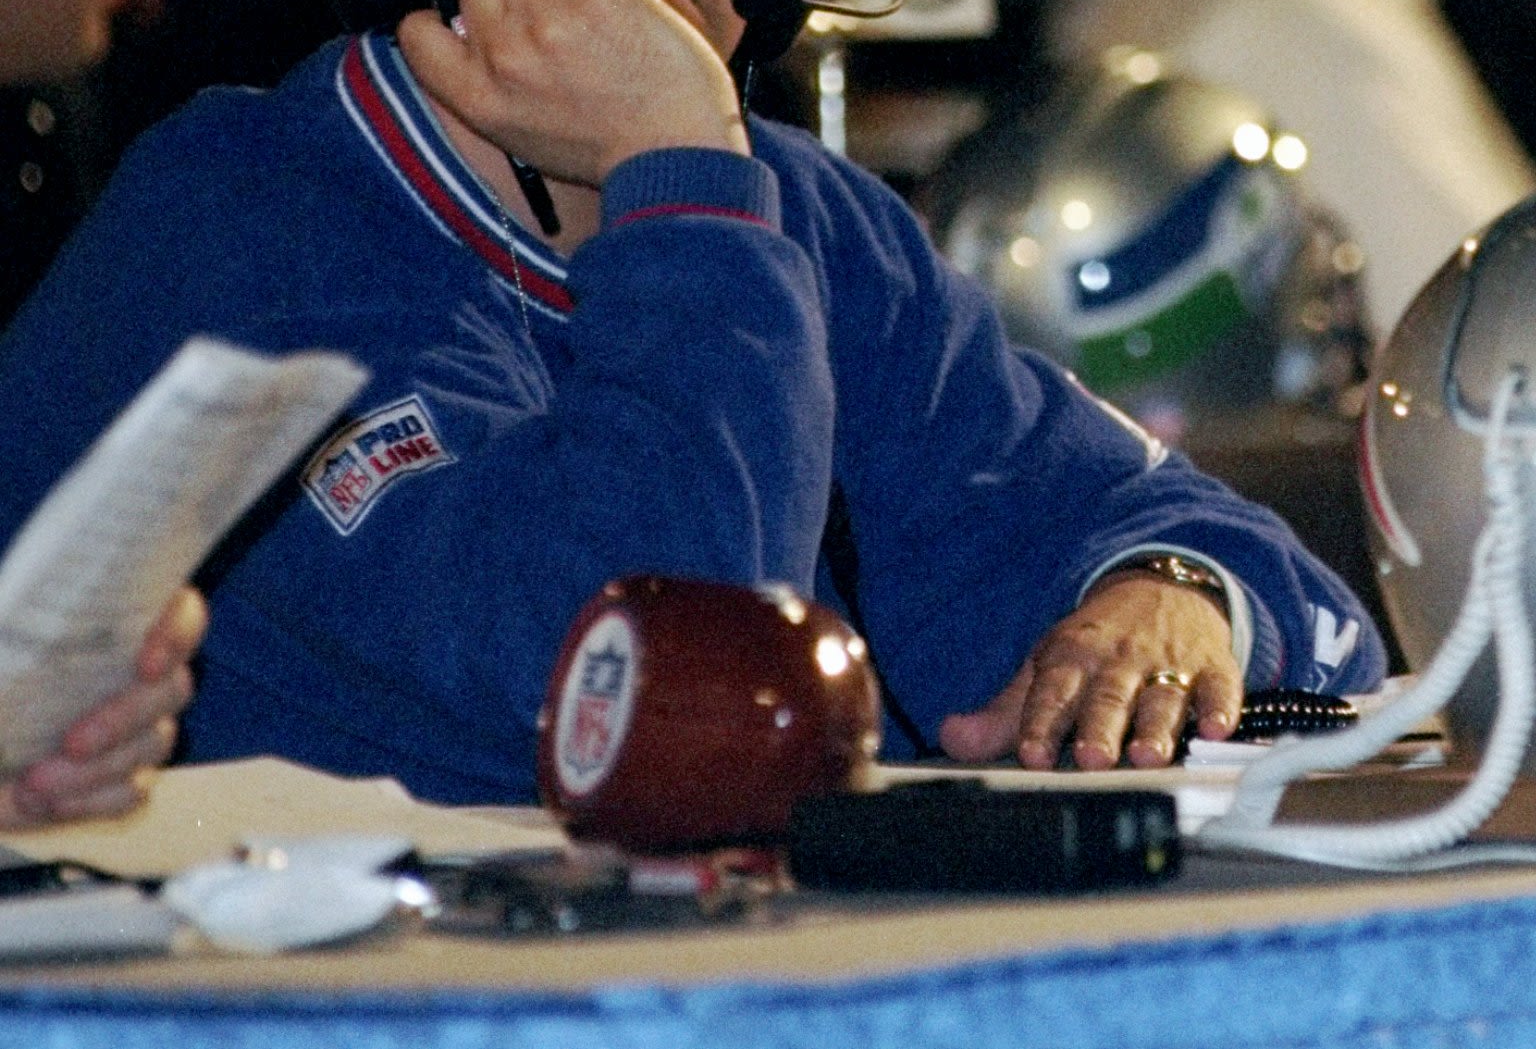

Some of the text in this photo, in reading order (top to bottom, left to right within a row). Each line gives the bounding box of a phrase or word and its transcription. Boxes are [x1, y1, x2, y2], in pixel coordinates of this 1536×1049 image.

[354, 414, 424, 455] PRO
[368, 435, 440, 476] LINE
[330, 468, 368, 511] NFL
